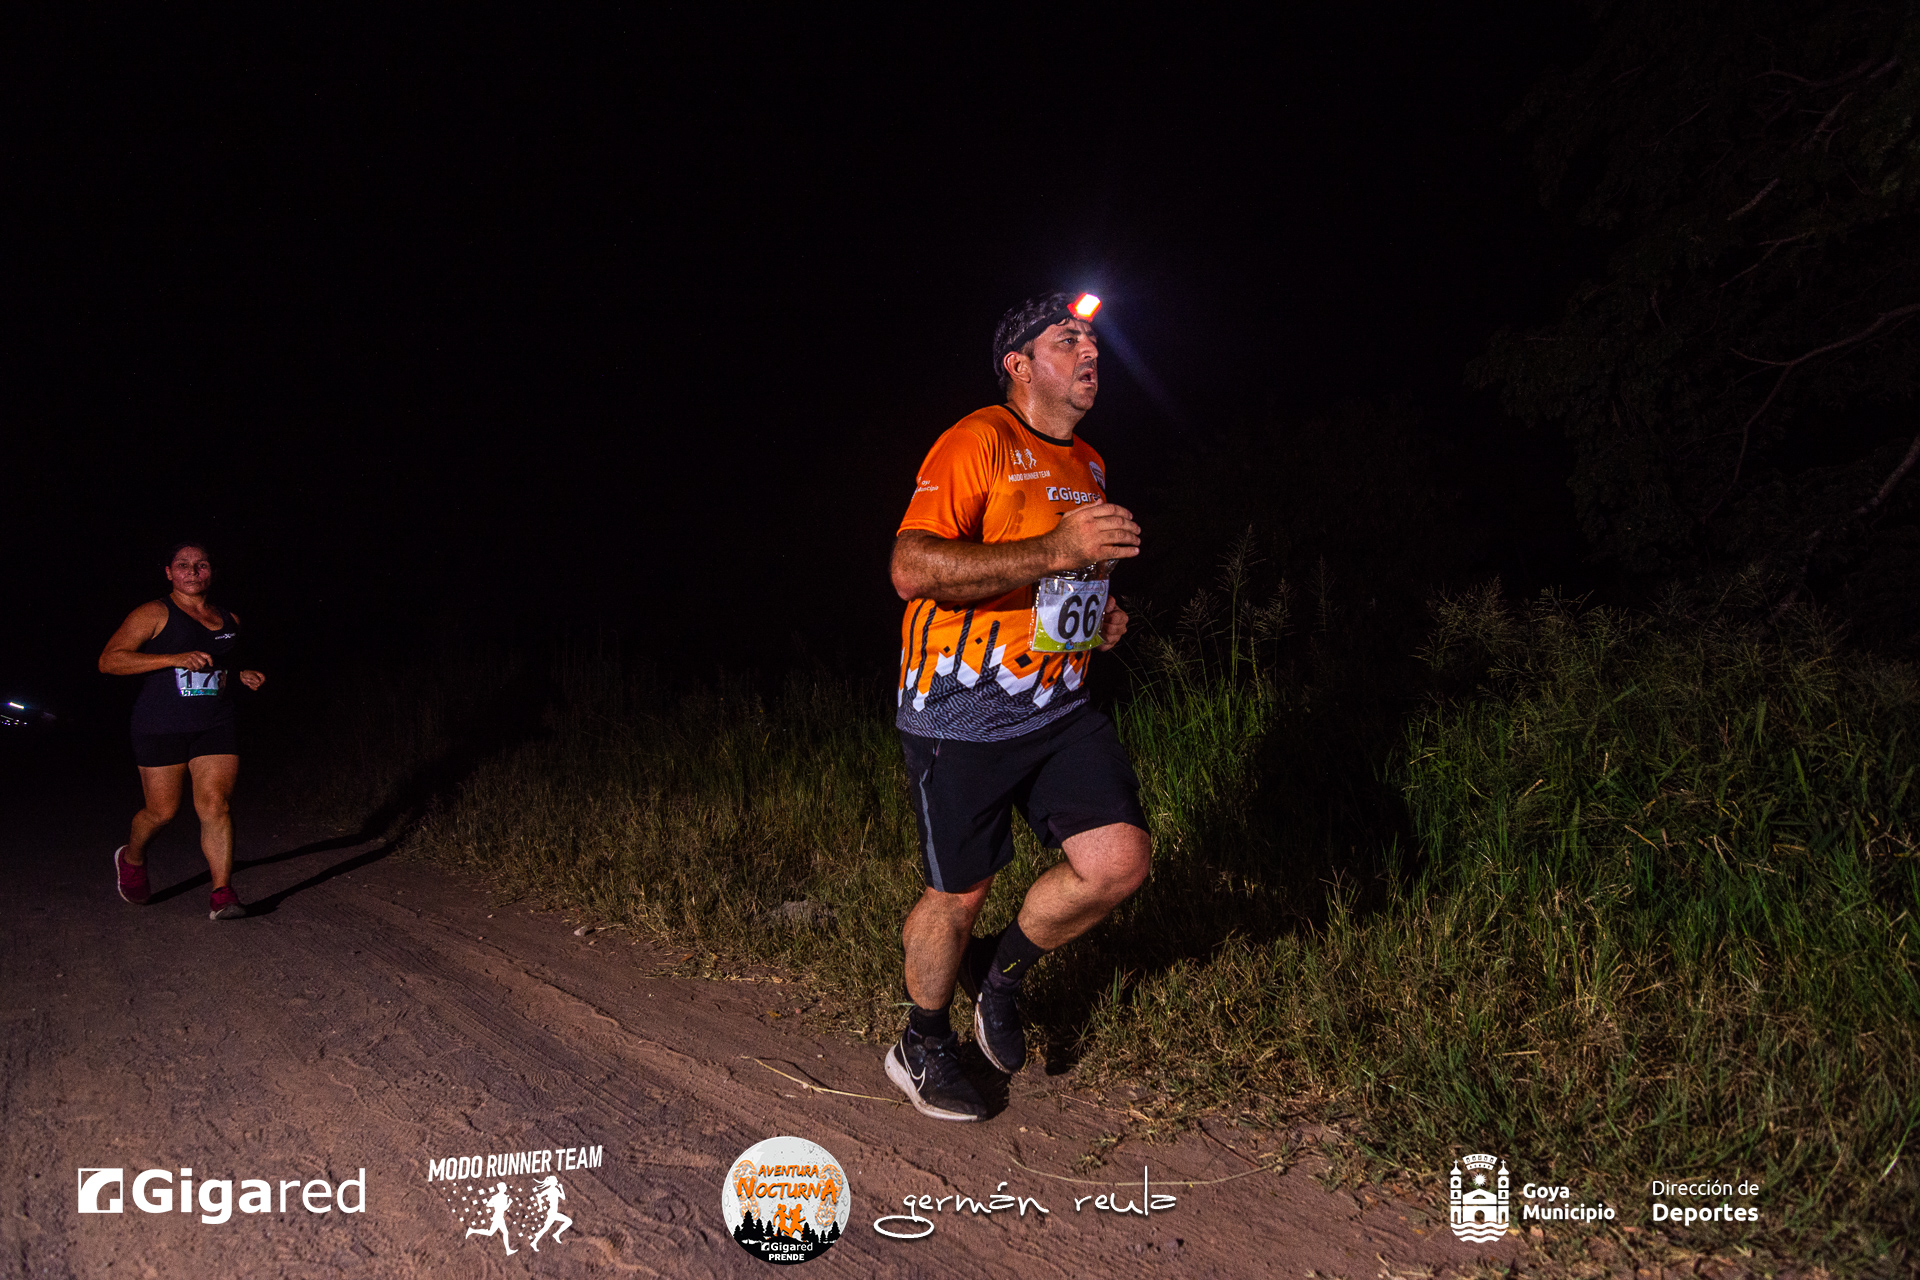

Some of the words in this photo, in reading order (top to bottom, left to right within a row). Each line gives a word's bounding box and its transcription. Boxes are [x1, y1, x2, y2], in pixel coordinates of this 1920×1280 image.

[1008, 474, 1023, 483] MODO
[1024, 472, 1039, 480] RUNNER
[1039, 470, 1051, 478] TEAM
[1058, 594, 1100, 640] 66
